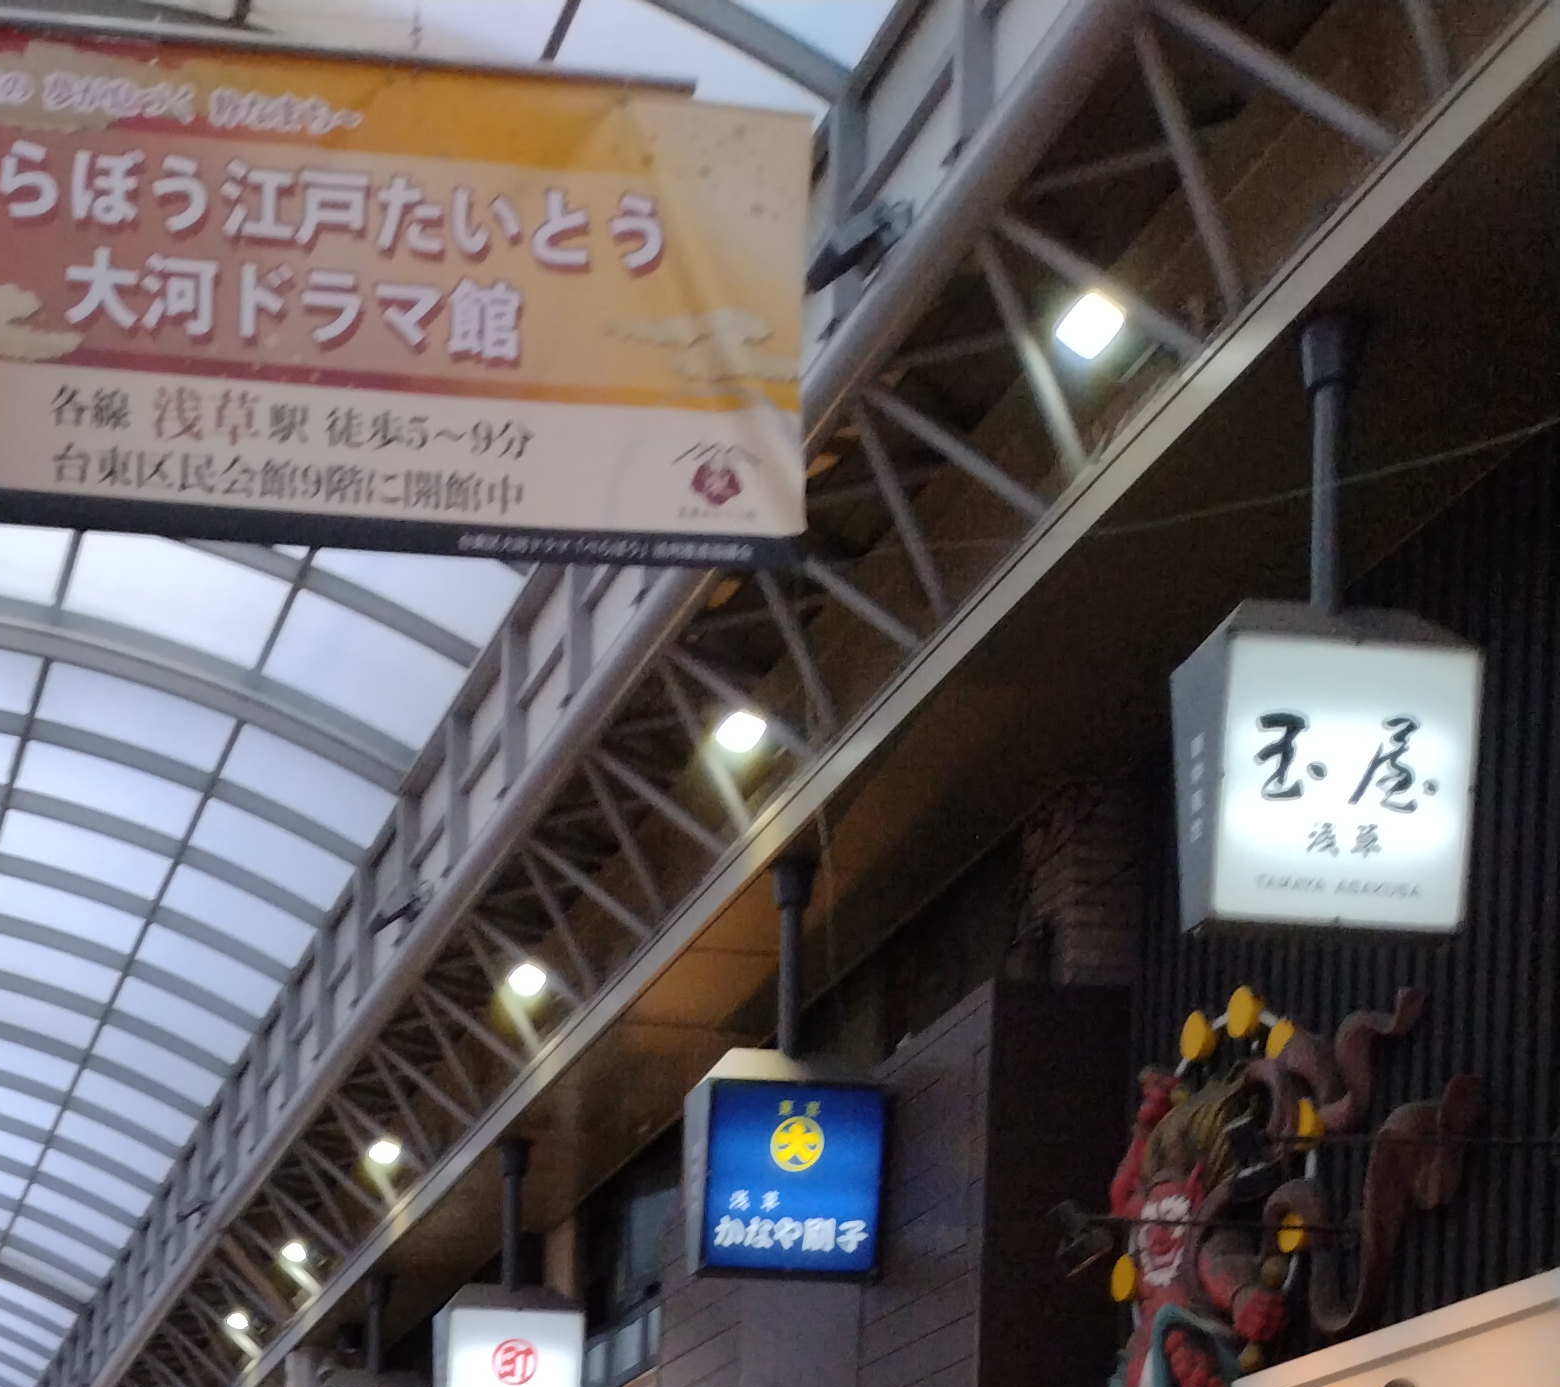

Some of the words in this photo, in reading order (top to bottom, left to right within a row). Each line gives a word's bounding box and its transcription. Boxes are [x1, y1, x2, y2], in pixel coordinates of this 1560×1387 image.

[63, 249, 524, 363] 大河ドラマ館
[52, 443, 524, 512] 台東区民会館9階に開館中
[1254, 708, 1438, 814] 玉屋
[1306, 823, 1381, 858] 浅草
[1255, 874, 1325, 893] TAMAYA
[1336, 880, 1420, 899] ASAKUSA
